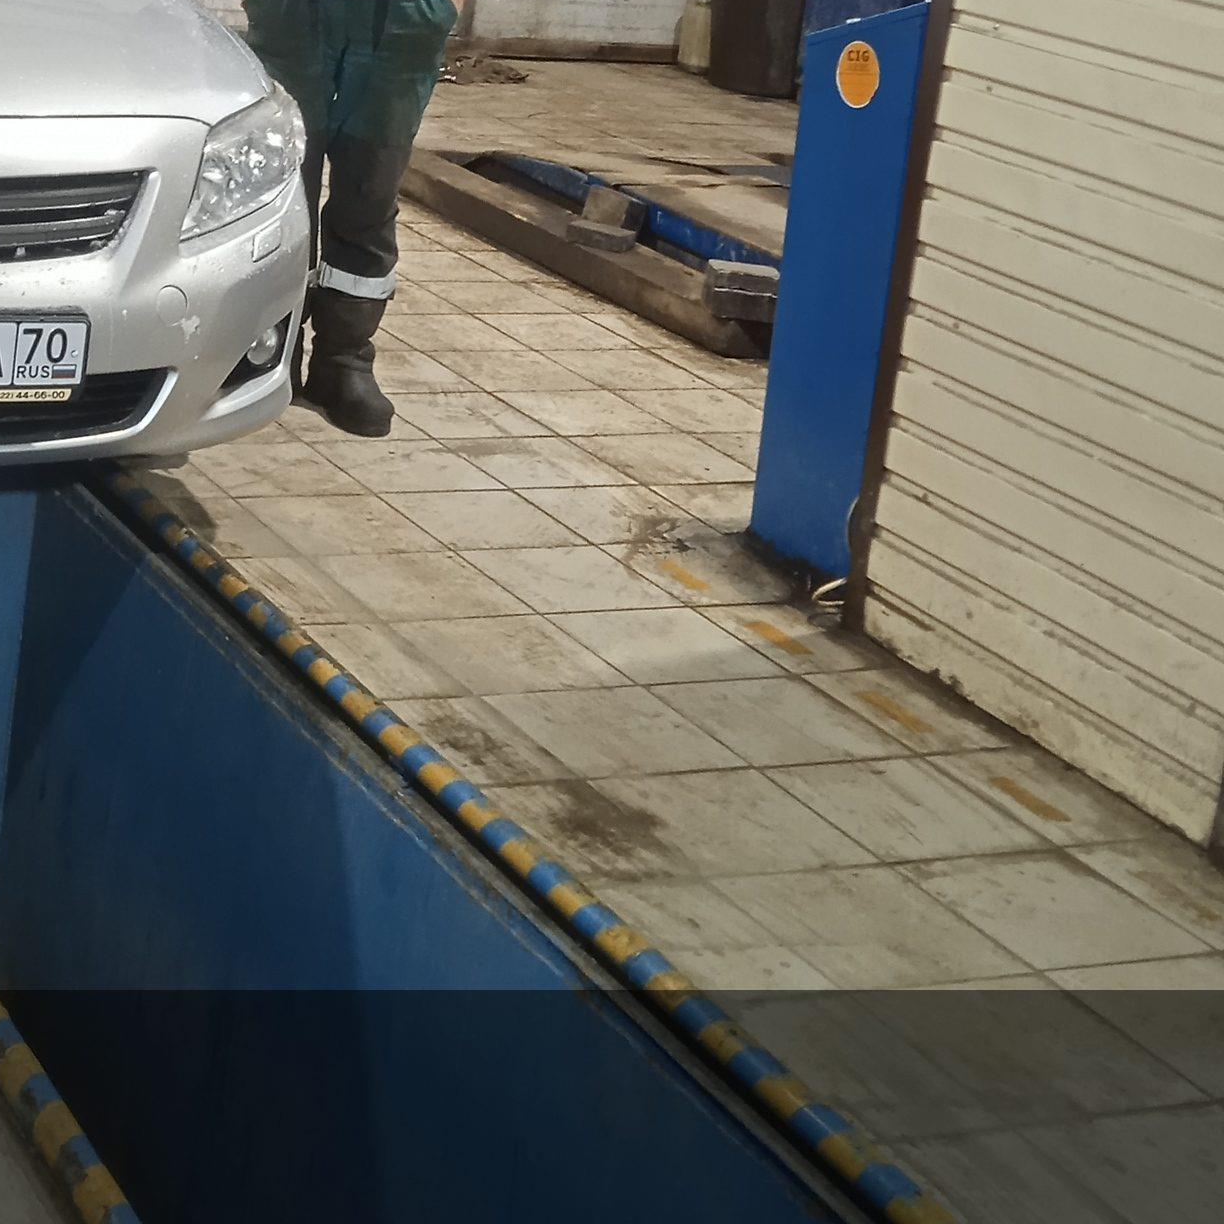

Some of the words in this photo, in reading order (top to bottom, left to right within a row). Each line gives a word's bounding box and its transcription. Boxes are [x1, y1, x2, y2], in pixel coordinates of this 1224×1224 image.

[22, 327, 69, 364] 70
[15, 365, 51, 379] RUS
[15, 390, 66, 400] 44-66-00
